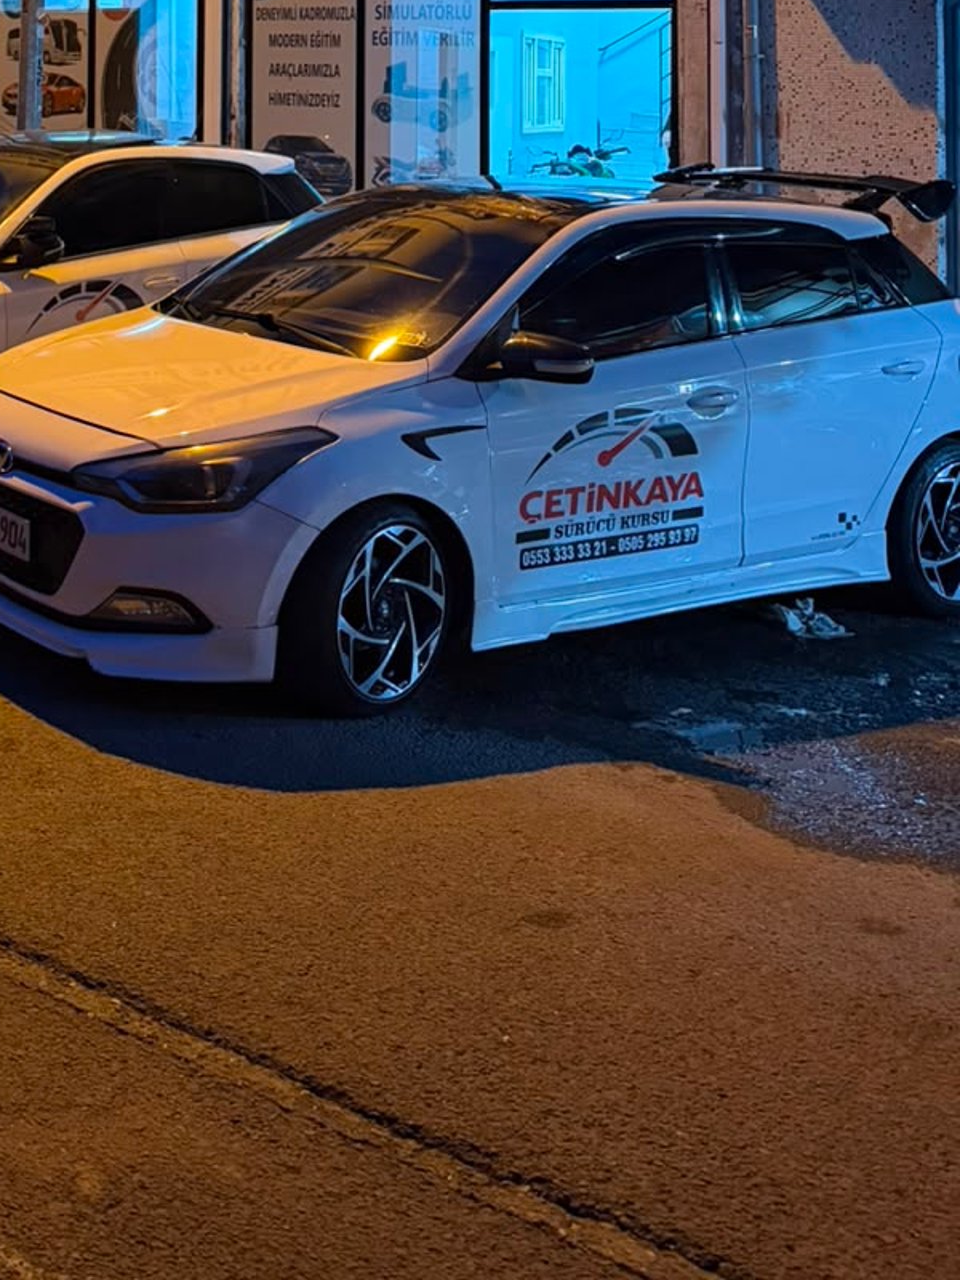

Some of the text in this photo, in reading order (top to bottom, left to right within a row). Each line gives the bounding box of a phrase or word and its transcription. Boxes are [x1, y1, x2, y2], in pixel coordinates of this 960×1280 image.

[268, 29, 341, 48] MODERN EĞİTİM
[371, 26, 419, 47] EĞİTİM
[0, 515, 27, 554] 904
[553, 510, 671, 541] SÜRÜCÜ KURSU
[522, 548, 551, 567] 0553
[553, 545, 575, 562] 333
[577, 542, 591, 558] 33
[593, 539, 607, 556] 21
[667, 528, 682, 544] 93
[683, 526, 697, 542] 97
